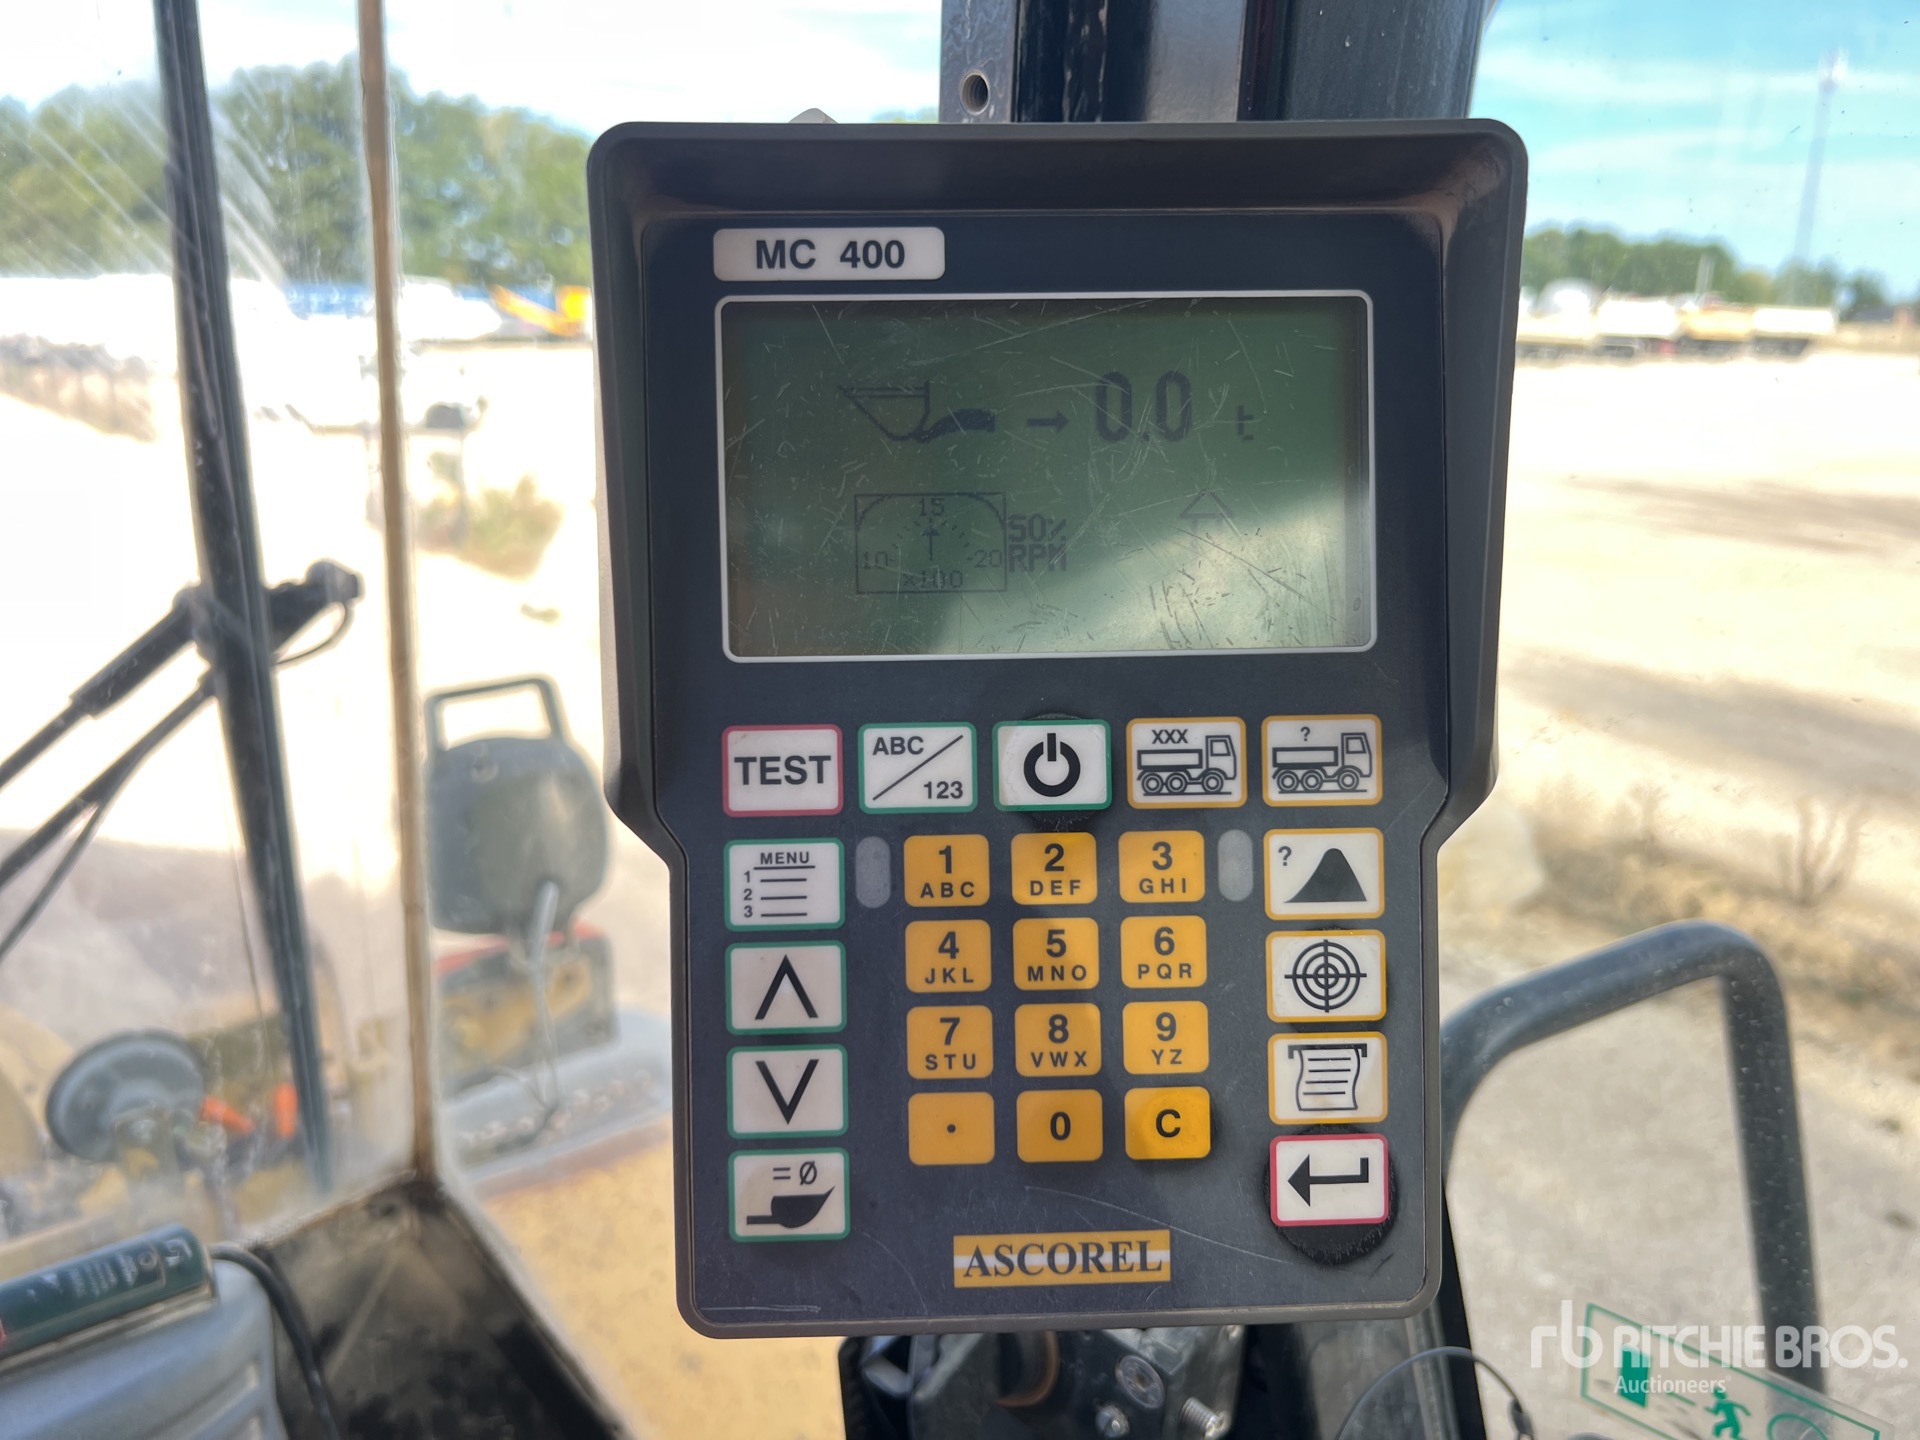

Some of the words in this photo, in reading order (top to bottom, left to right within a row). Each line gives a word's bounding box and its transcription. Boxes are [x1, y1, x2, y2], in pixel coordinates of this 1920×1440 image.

[755, 240, 816, 269] MC
[840, 240, 905, 268] 400
[1096, 370, 1193, 442] 0.0
[919, 498, 945, 517] 15
[1008, 513, 1067, 543] 50%
[973, 550, 1003, 568] 20
[1008, 543, 1067, 573] RPM
[872, 735, 925, 755] ABC
[1300, 726, 1311, 742] ?
[734, 755, 831, 785] TEST
[923, 781, 964, 800] 123
[760, 851, 810, 865] MENU
[938, 845, 953, 874] 1
[1044, 843, 1065, 872] 2
[1152, 841, 1173, 870] 3
[1278, 845, 1292, 866] ?
[744, 870, 752, 883] 1
[743, 889, 753, 901] 2
[743, 906, 753, 918] 3
[938, 931, 959, 959] 4
[1046, 929, 1067, 958] 5
[1154, 926, 1175, 955] 6
[939, 1017, 961, 1045] 7
[1048, 1014, 1069, 1043] 8
[1155, 1012, 1177, 1041] 9
[1050, 1111, 1071, 1140] 0
[1155, 1108, 1181, 1138] C
[963, 1240, 1162, 1278] ASCOREL
